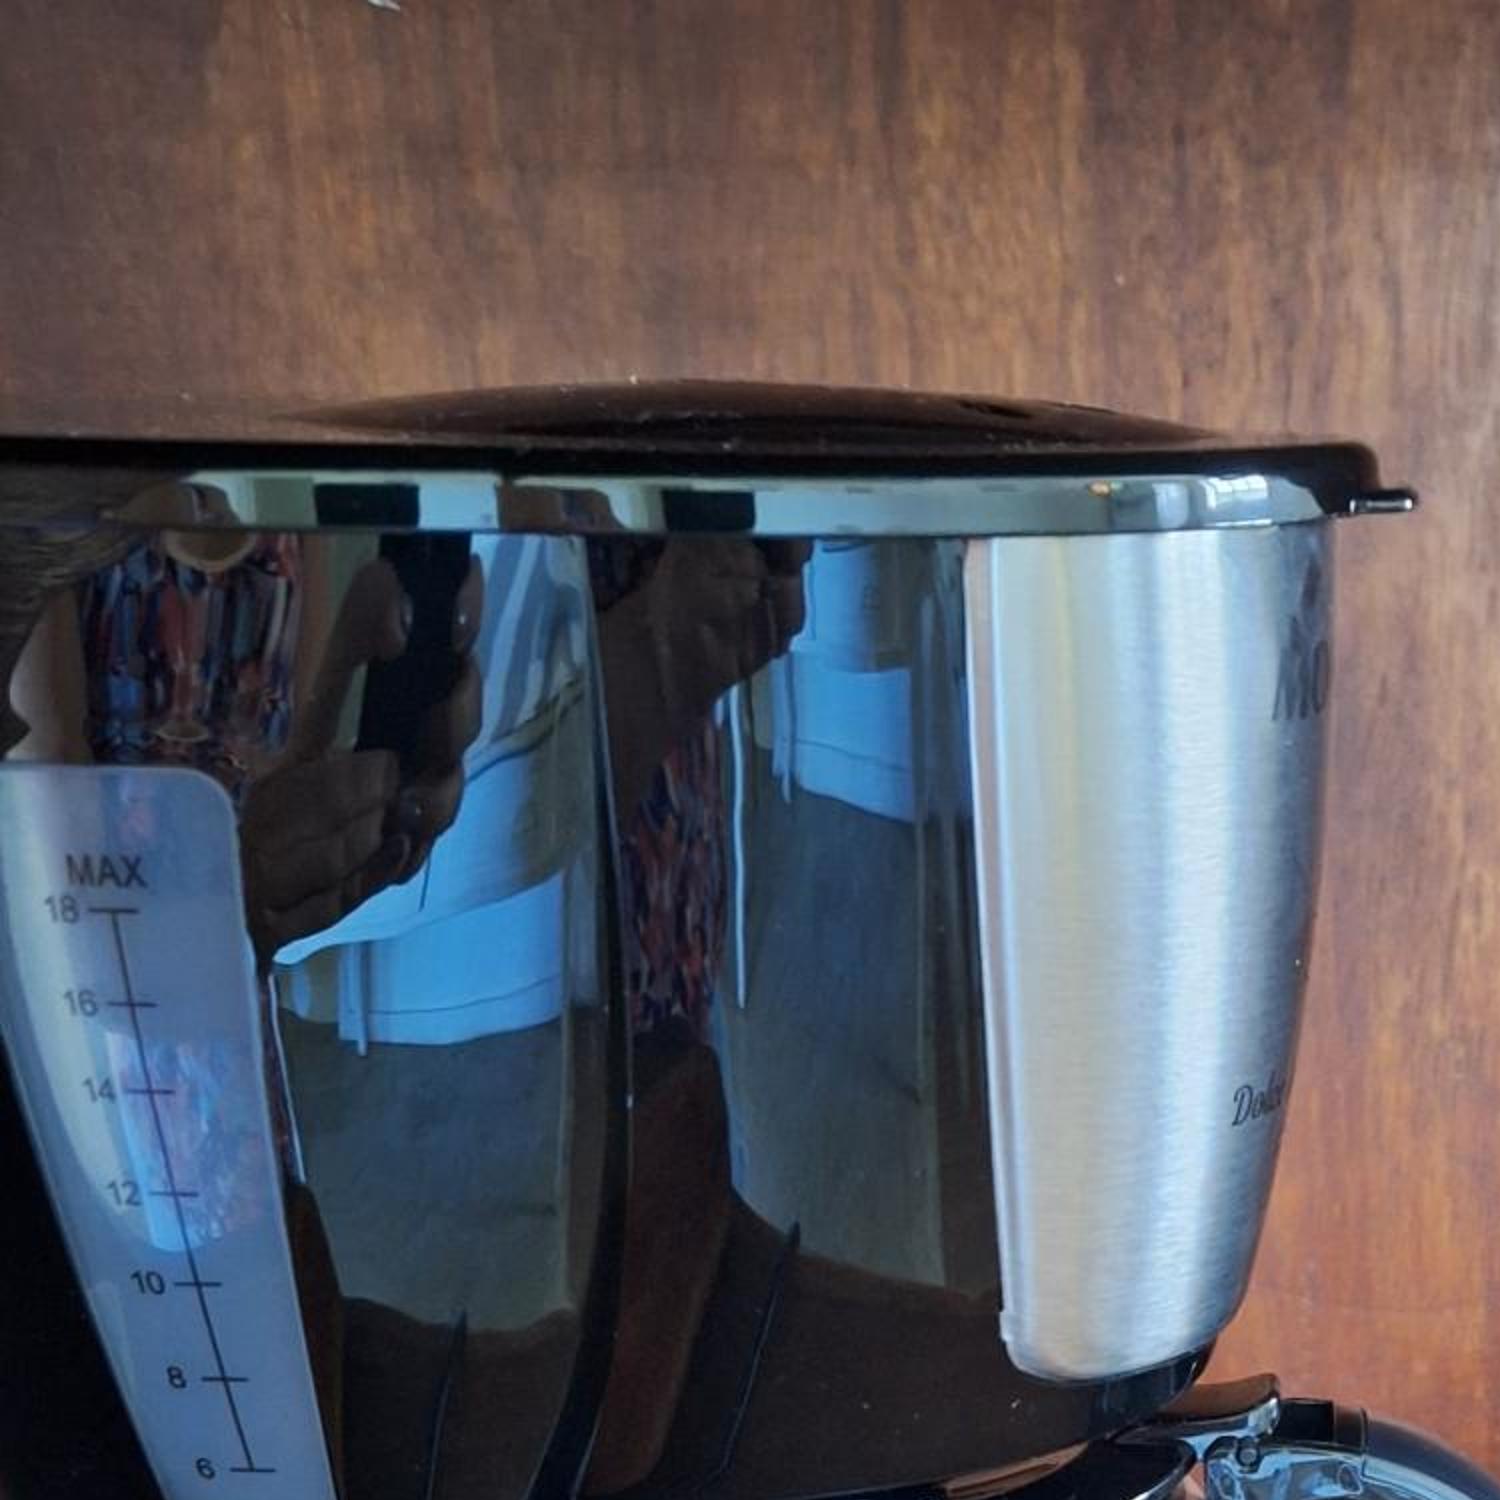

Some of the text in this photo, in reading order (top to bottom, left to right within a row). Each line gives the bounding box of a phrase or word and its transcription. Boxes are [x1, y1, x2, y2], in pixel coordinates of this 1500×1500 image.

[66, 854, 148, 888] MAX
[44, 895, 80, 924] 18
[63, 988, 98, 1017] 16
[82, 1076, 116, 1103] 14
[106, 1180, 142, 1206] 12
[131, 1270, 165, 1296] 10
[166, 1365, 188, 1390] 8
[195, 1456, 217, 1480] 6
